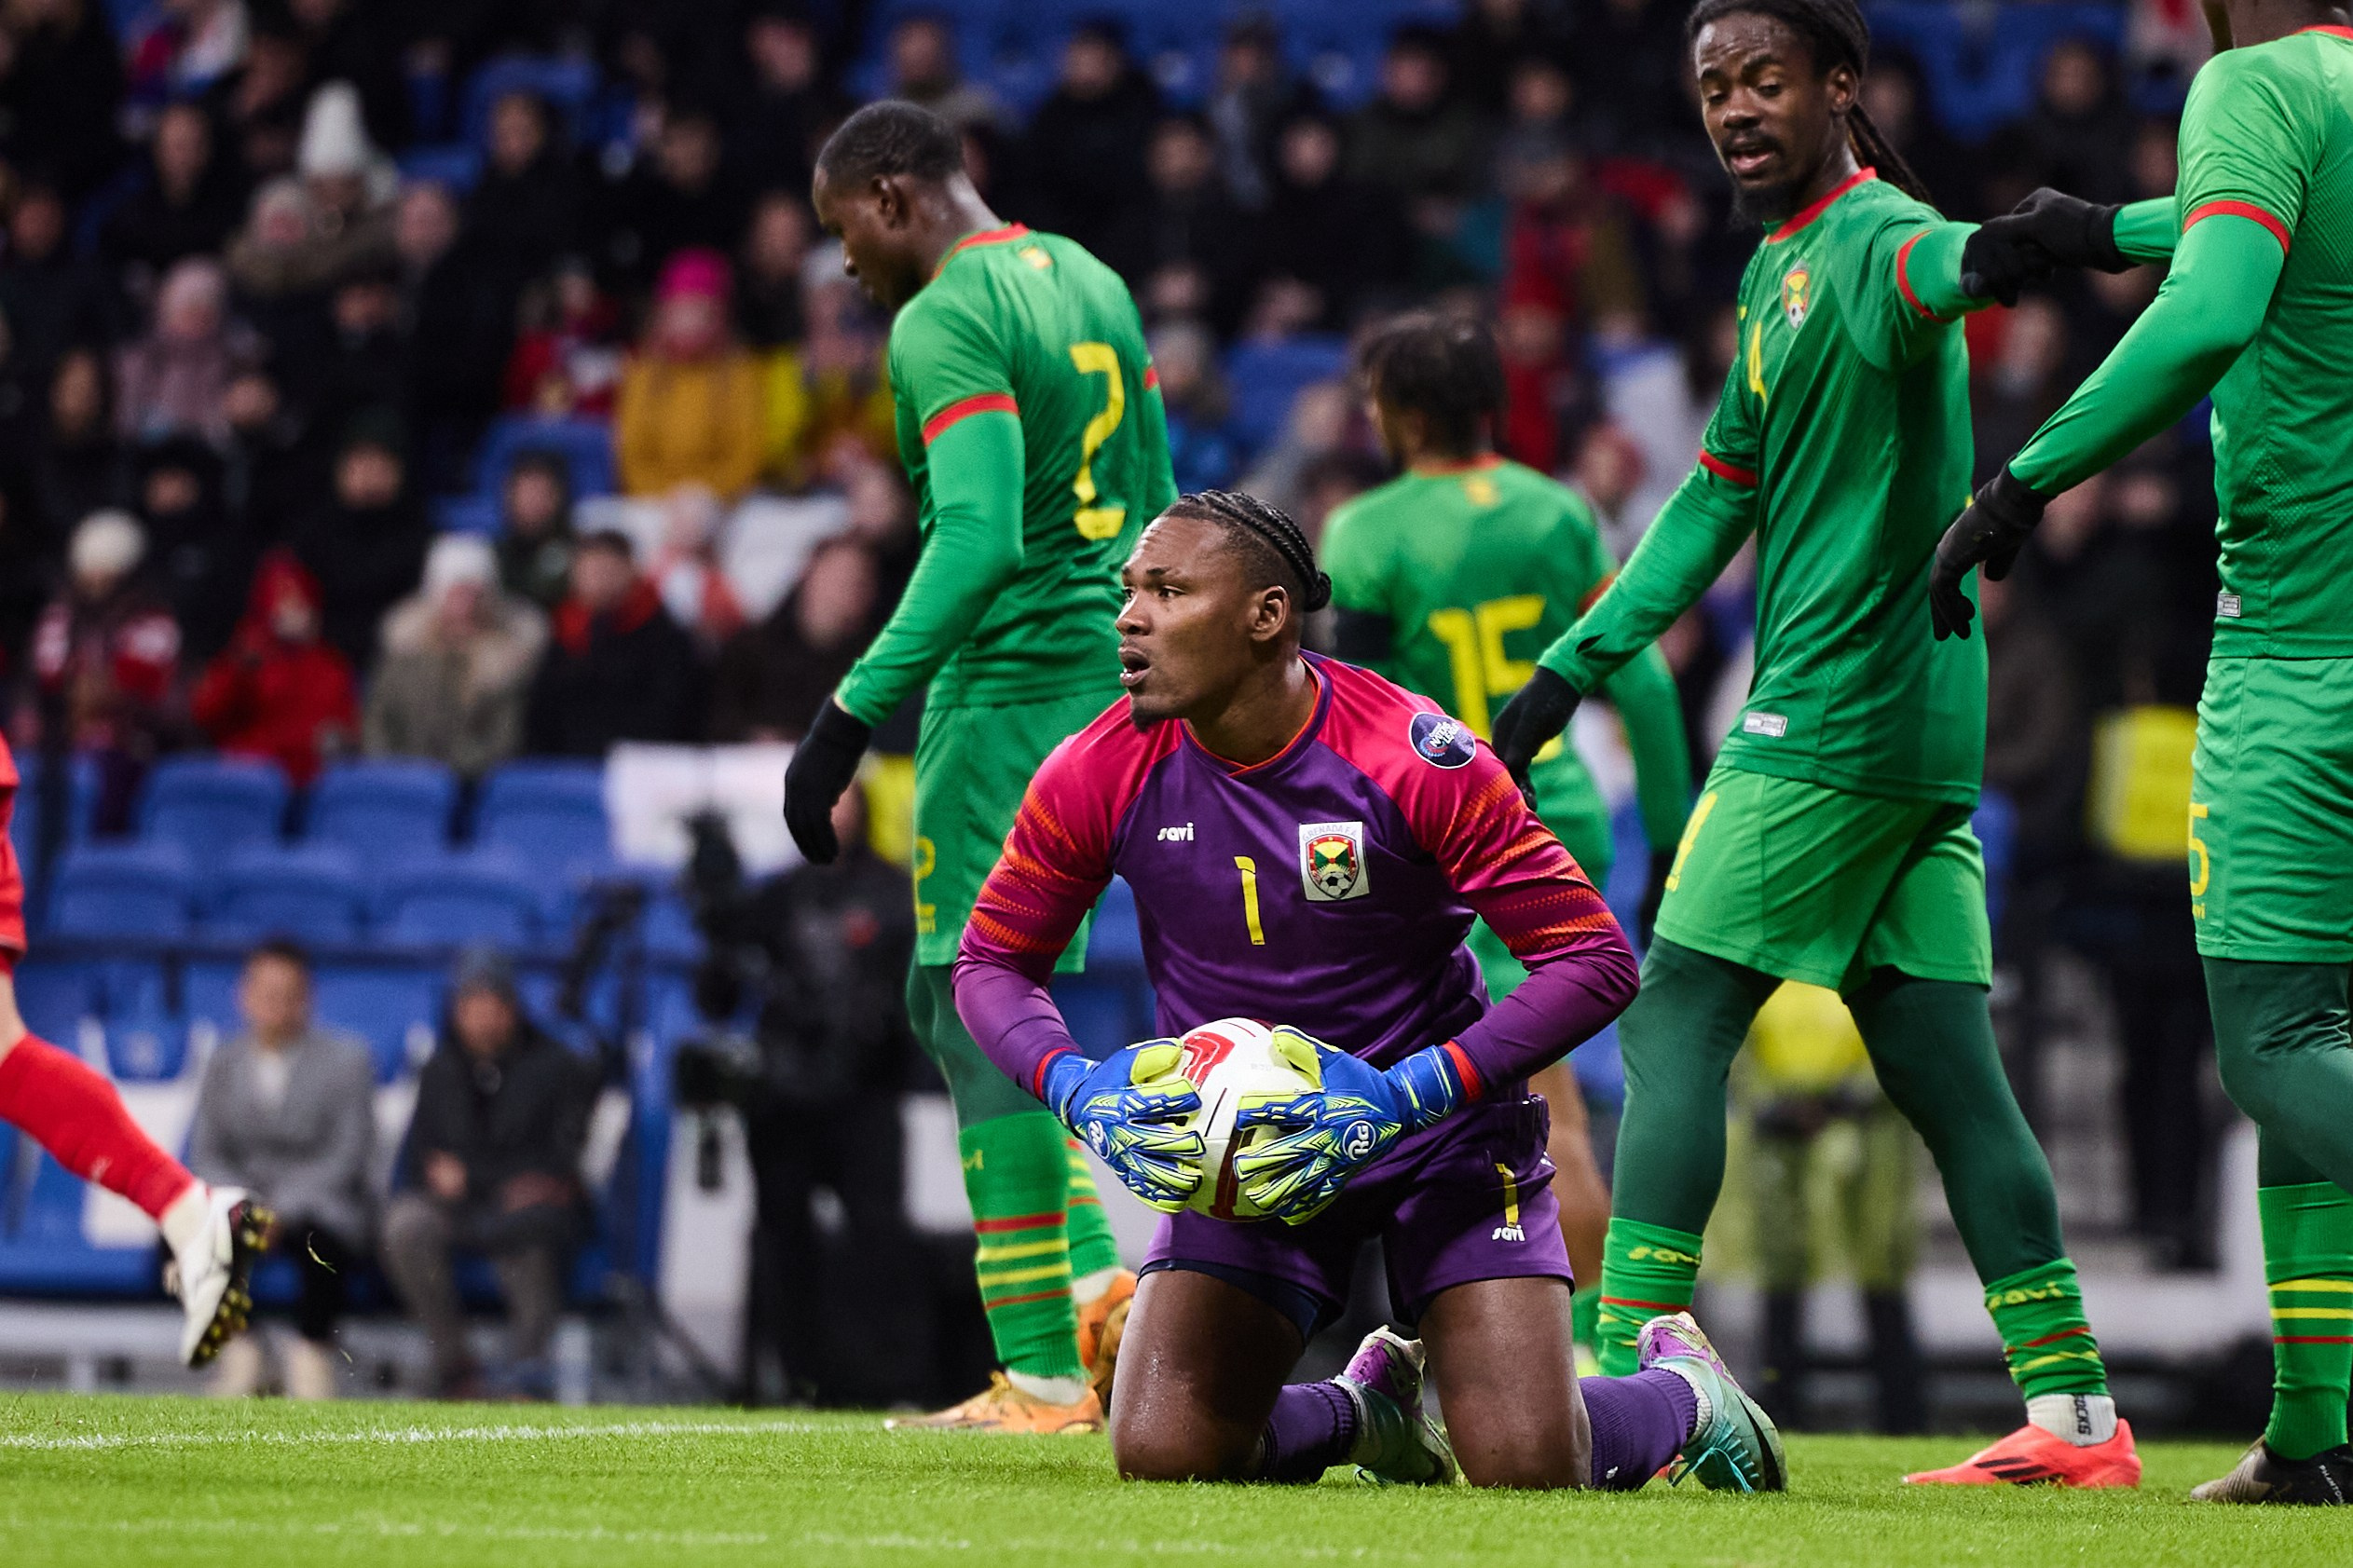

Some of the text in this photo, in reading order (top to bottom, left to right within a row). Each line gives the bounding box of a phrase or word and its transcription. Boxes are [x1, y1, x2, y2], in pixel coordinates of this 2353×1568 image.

[1071, 342, 1126, 540] 2
[1156, 822, 1194, 841] savi
[1303, 825, 1343, 842] GRENADA
[1234, 855, 1265, 946] 1
[1495, 1163, 1519, 1227] 1
[1492, 1224, 1525, 1242] savi
